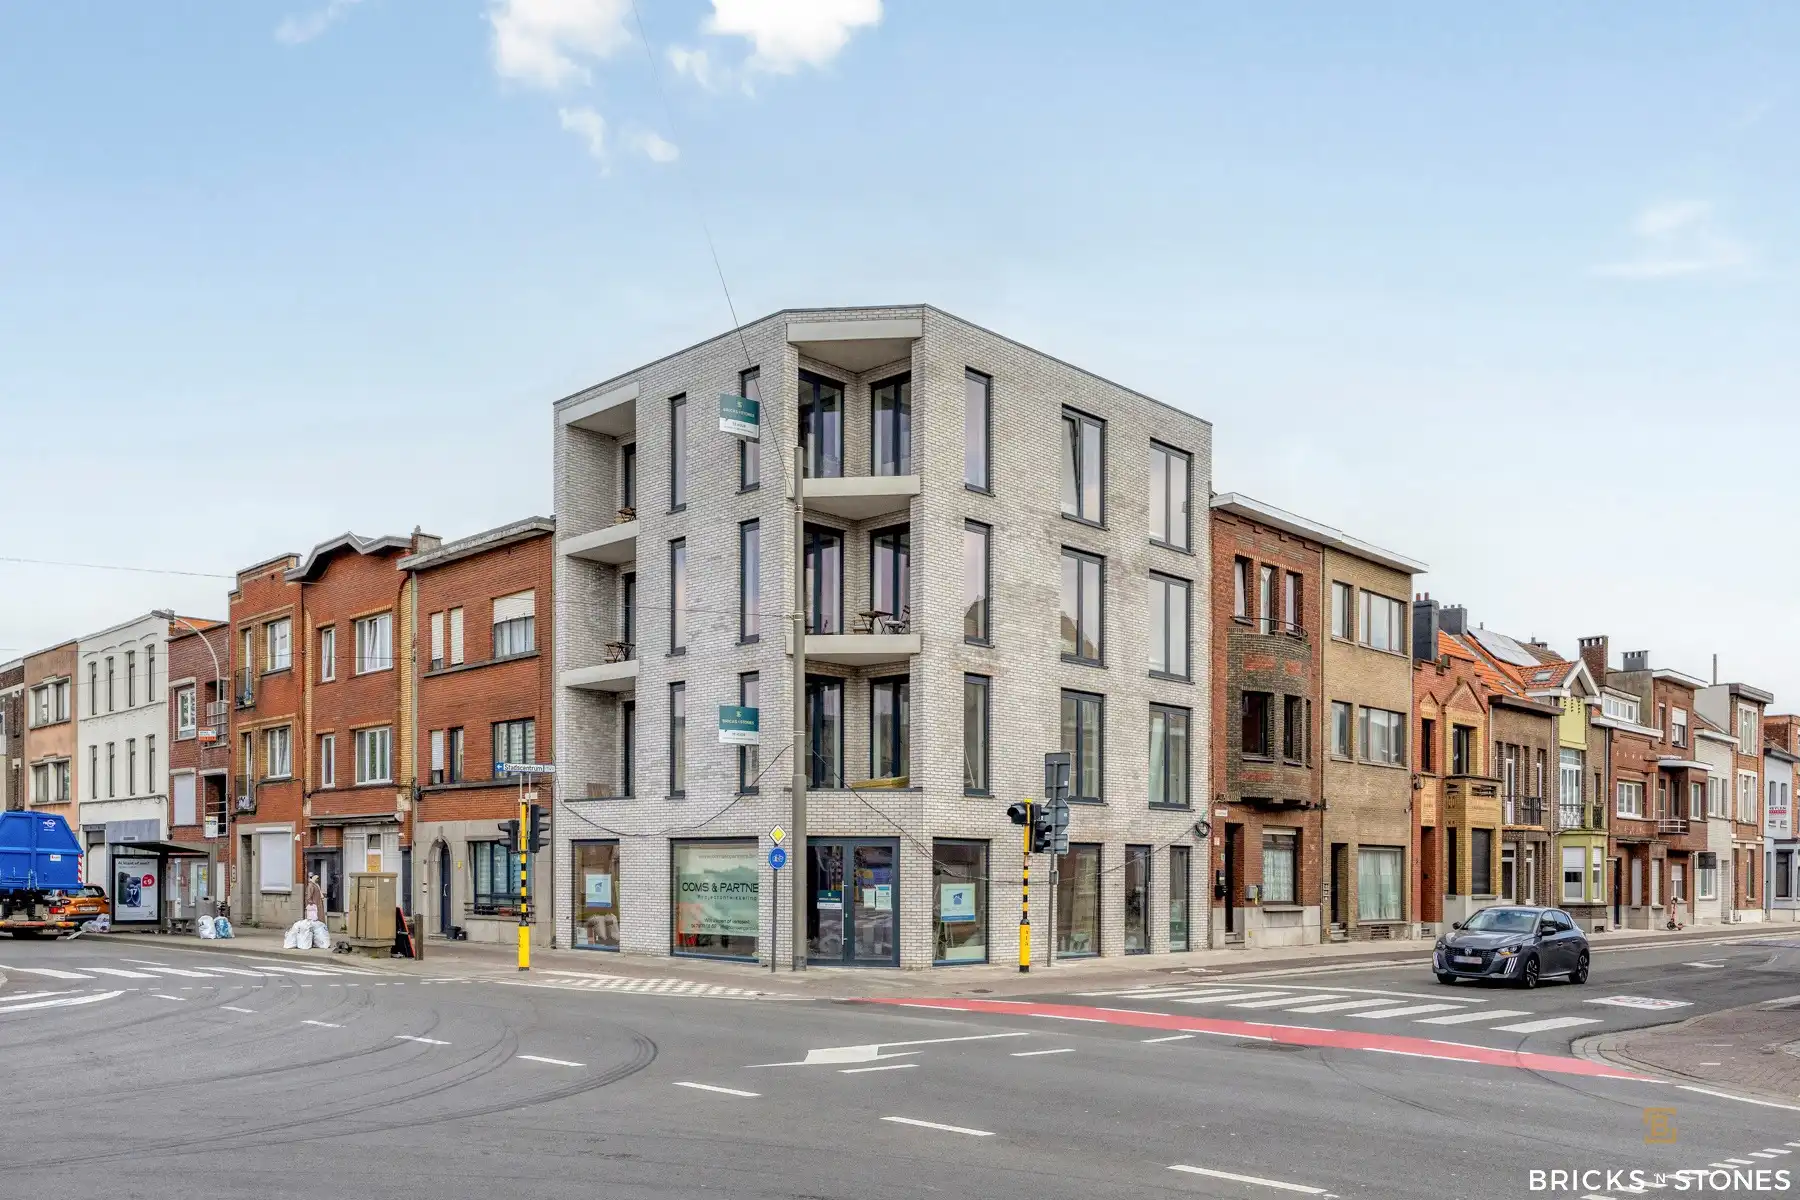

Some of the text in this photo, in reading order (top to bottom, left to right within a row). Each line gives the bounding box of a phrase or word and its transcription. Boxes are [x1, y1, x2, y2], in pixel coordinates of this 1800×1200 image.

[505, 763, 543, 771] Stadscentrum
[682, 882, 709, 892] OOMS
[711, 882, 718, 893] &
